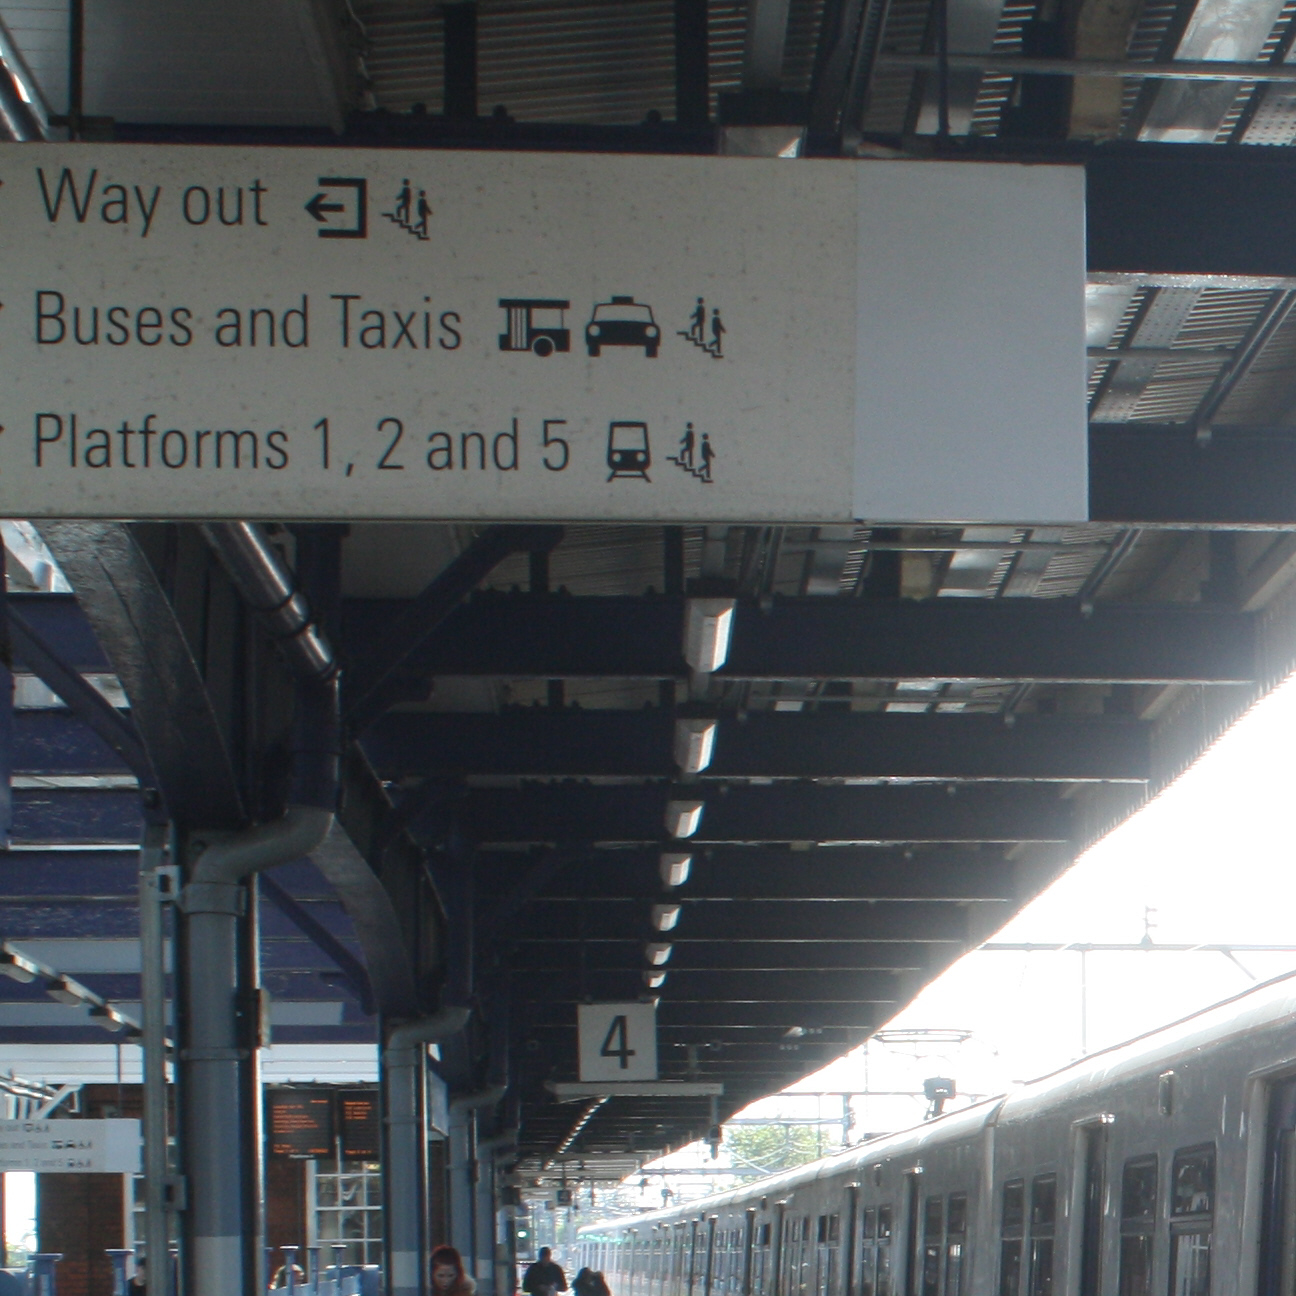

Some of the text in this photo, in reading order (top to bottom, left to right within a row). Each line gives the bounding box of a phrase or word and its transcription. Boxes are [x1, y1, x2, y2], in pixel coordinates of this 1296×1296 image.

[36, 167, 269, 238] Way out
[35, 289, 462, 351] Buses and Taxis
[34, 412, 570, 478] Platforms 1, 2 and 5
[600, 1015, 636, 1069] 4
